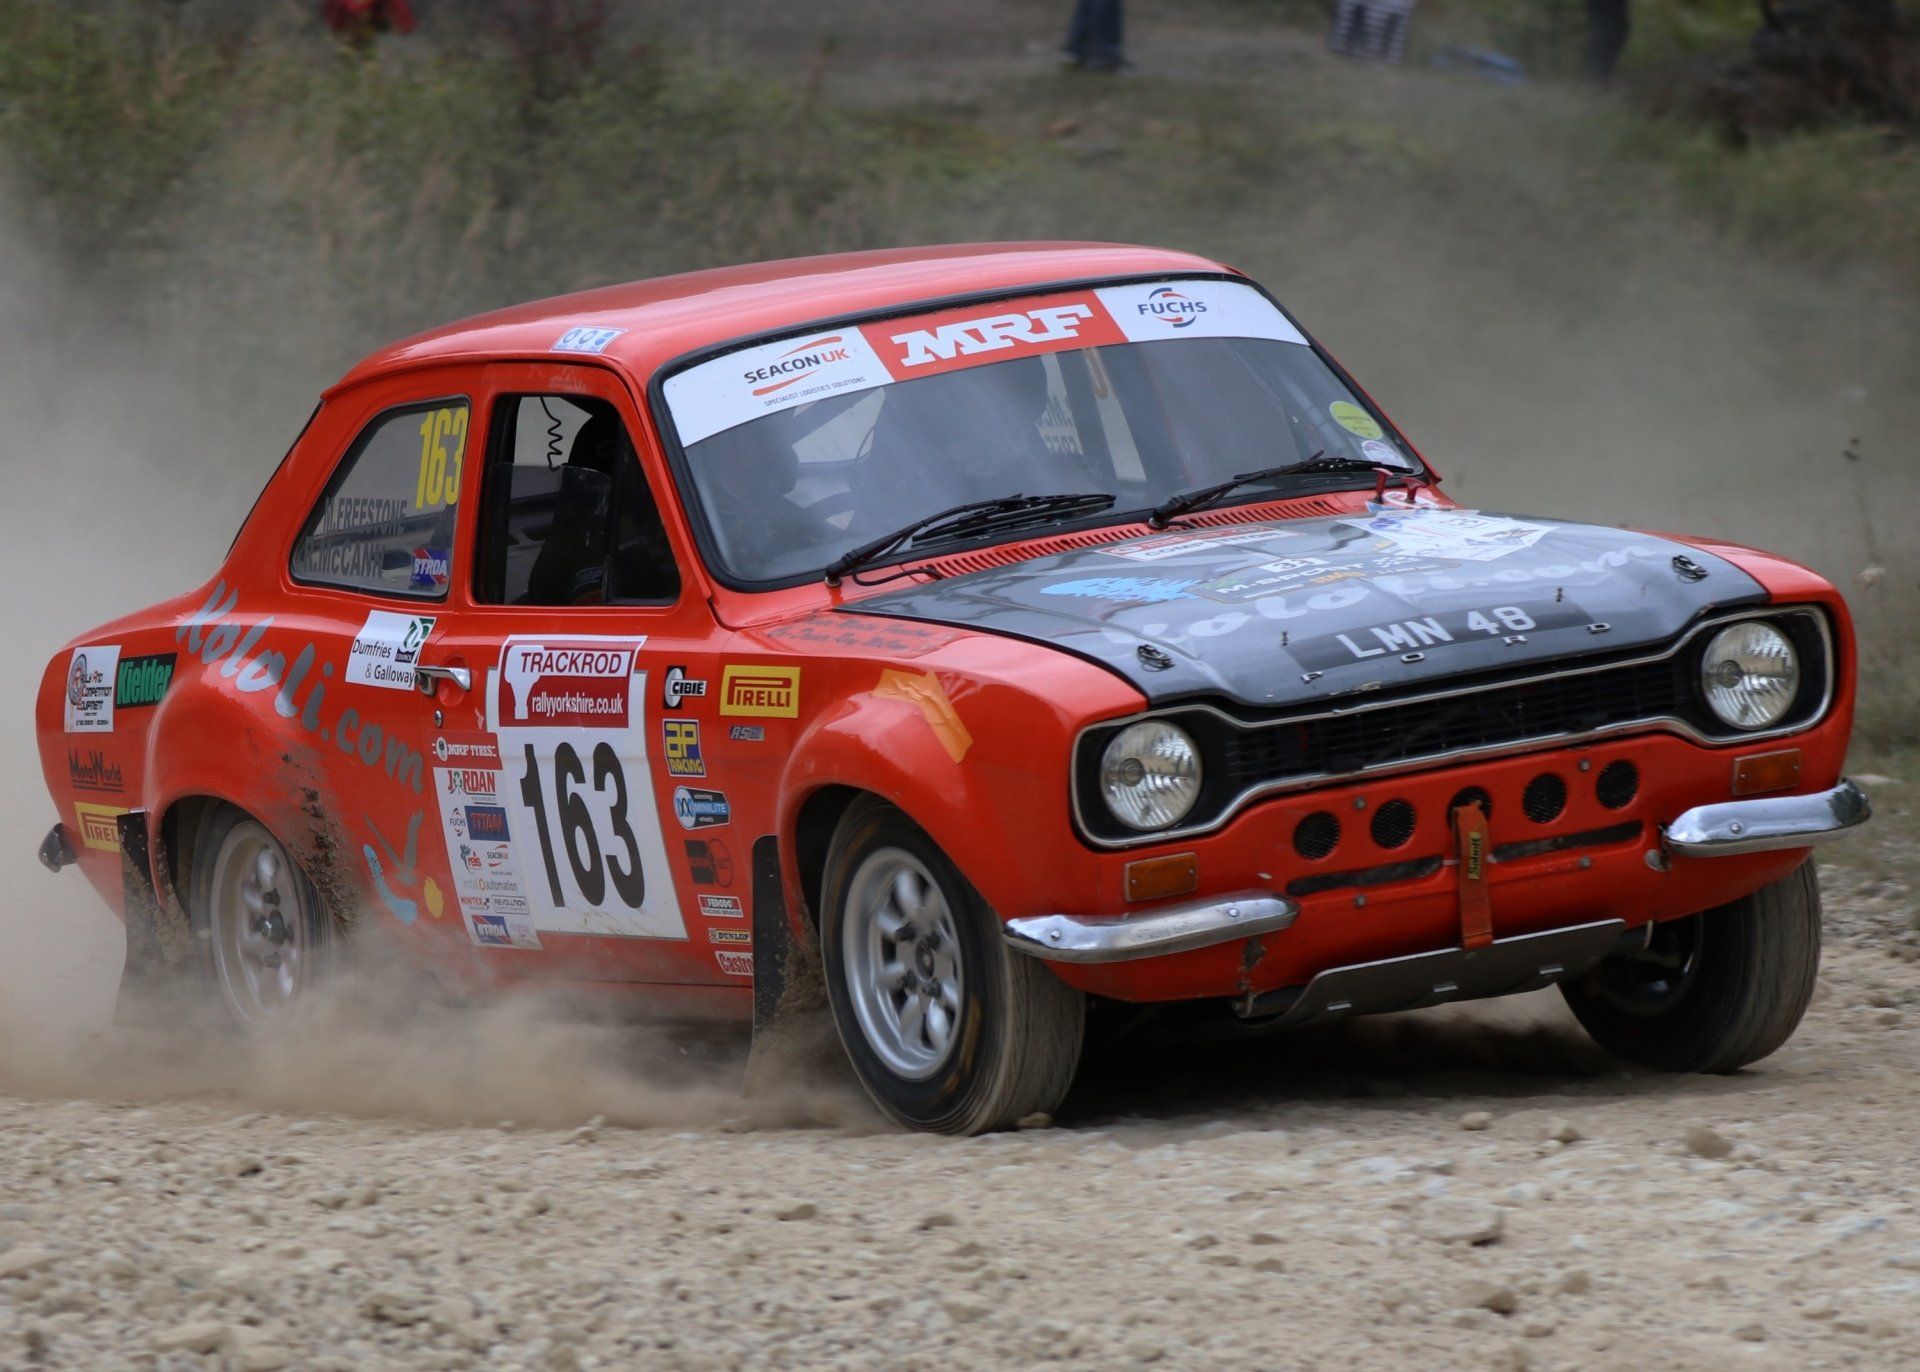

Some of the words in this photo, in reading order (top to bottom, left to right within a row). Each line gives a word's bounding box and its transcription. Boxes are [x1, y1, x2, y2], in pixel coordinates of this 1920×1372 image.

[1137, 301, 1207, 316] FUCHS
[890, 304, 1094, 367] MRF
[744, 354, 820, 384] SEACON
[821, 348, 850, 363] UK
[764, 392, 799, 407] SPECIALIST
[800, 384, 832, 398] LOGISTICS
[832, 376, 866, 391] SOLUTIONS
[416, 408, 469, 509] 163
[413, 558, 448, 577] BTRDA
[1215, 563, 1365, 594] M-SPORT
[1336, 617, 1454, 658] LMN
[1467, 606, 1537, 634] 48
[352, 639, 392, 659] Dumfries
[365, 663, 372, 679] &
[374, 665, 415, 687] Galloway
[521, 652, 621, 674] TRACKROD
[117, 659, 172, 705] Kielder
[176, 578, 425, 794] Kololi.com
[727, 676, 792, 707] PIRELLI
[532, 692, 623, 717] rallyyorkshire.co.uk
[448, 744, 469, 756] MRF
[470, 745, 494, 757] TYRES
[669, 759, 703, 774] RACING
[447, 770, 496, 793] JORDAN
[81, 812, 119, 843] PIREL
[449, 818, 467, 828] FUCHS
[520, 742, 645, 908] 163
[717, 932, 749, 940] DUNLOP
[719, 953, 753, 974] Castro
